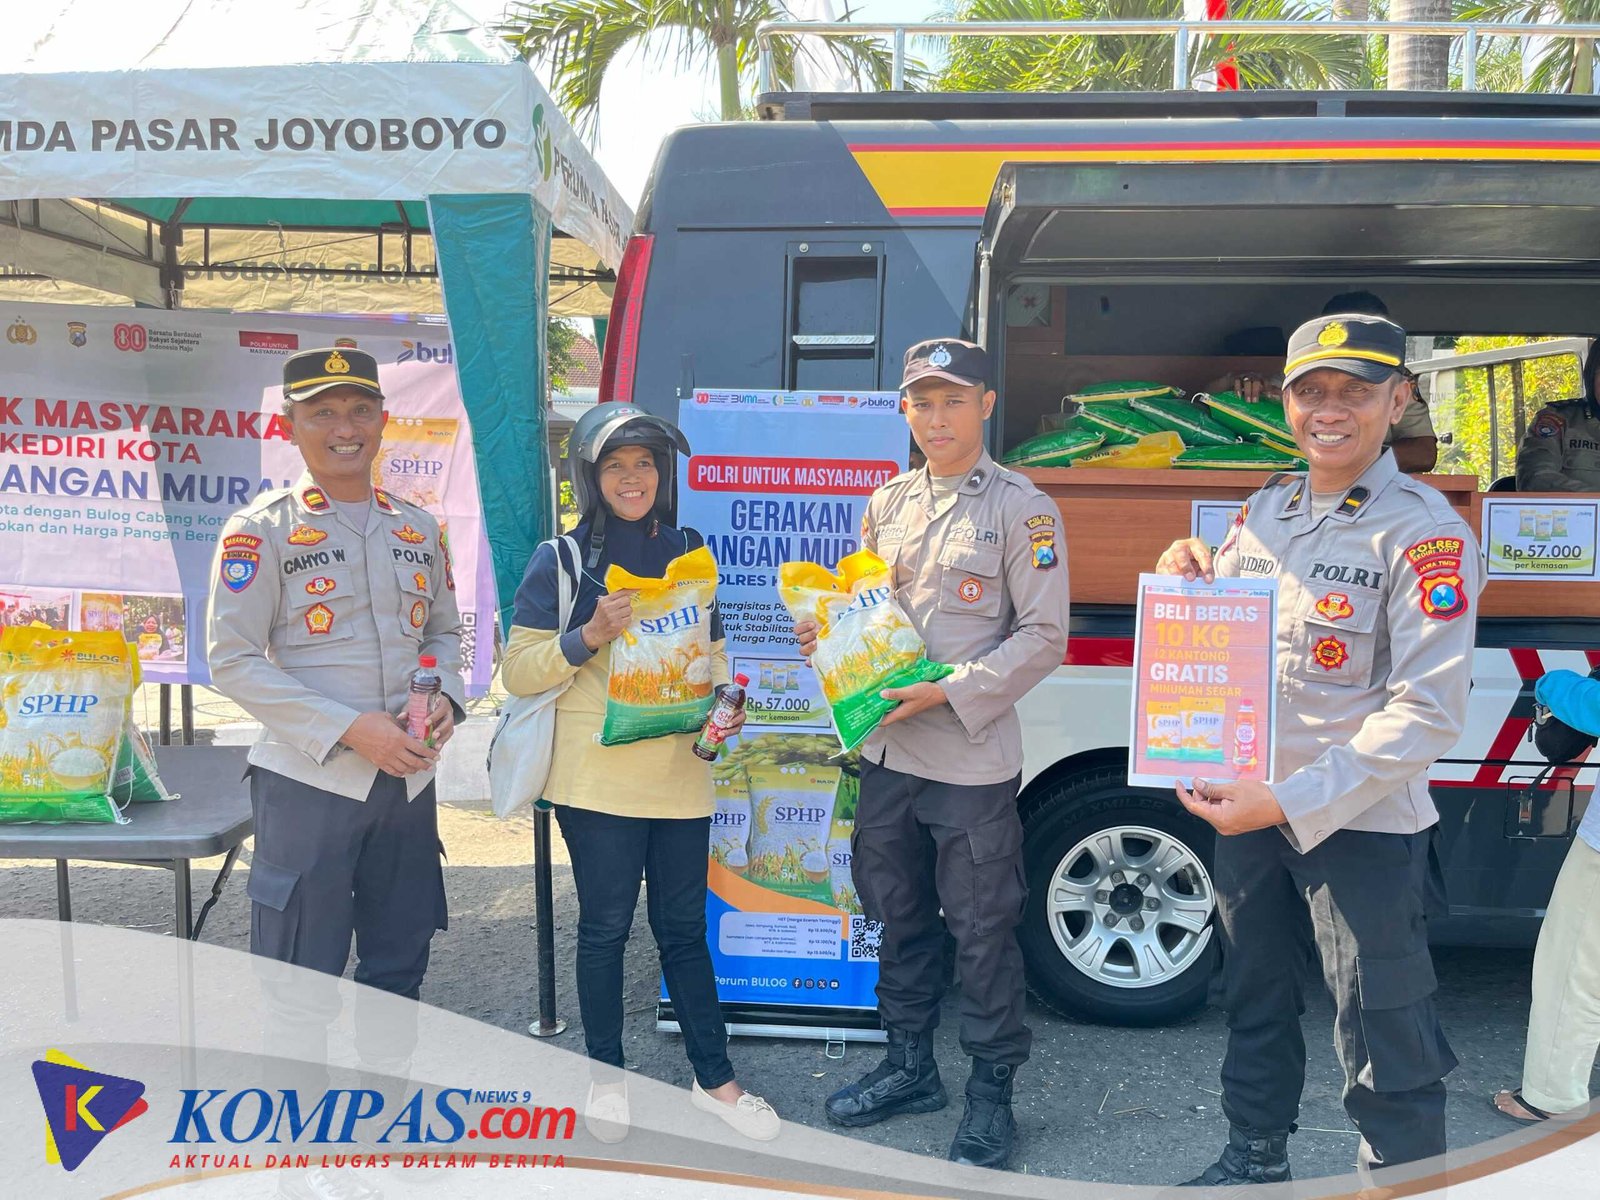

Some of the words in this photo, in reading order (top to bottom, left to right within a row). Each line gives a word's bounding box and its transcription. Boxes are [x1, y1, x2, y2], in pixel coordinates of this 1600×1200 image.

[91, 118, 240, 152] PASAR
[255, 117, 507, 151] JOYOBOYO
[0, 397, 24, 425] K
[868, 398, 896, 409] bulog
[0, 432, 105, 459] KEDIRI
[117, 438, 202, 465] KOTA
[390, 458, 443, 475] SPHP
[1, 463, 149, 500] ANGAN
[697, 465, 738, 484] POLRI
[743, 467, 791, 486] UNTUK
[795, 468, 892, 488] MASYARAKAT
[23, 505, 81, 520] dengan
[86, 508, 131, 524] Bulog
[136, 511, 193, 526] Cabang
[731, 499, 853, 534] GERAKAN
[39, 522, 67, 534] dan
[73, 524, 118, 539] Harga
[123, 527, 180, 542] Pangan
[185, 531, 218, 542] Bera
[954, 526, 999, 545] POLRI
[391, 548, 435, 567] POLRI
[1408, 540, 1460, 559] POLRES
[1503, 544, 1523, 560] Rp
[1527, 545, 1582, 558] 57.000
[283, 552, 329, 576] CAHYO
[332, 549, 346, 562] W
[1515, 562, 1530, 570] per
[1531, 561, 1568, 569] kemasan
[1308, 563, 1384, 591] POLRI
[743, 613, 773, 623] Bulog
[1154, 603, 1191, 620] BELI
[1196, 605, 1258, 622] BERAS
[745, 624, 794, 633] Stabilitas
[1156, 622, 1185, 647] 10
[1192, 624, 1231, 649] KG
[733, 634, 765, 644] Harga
[76, 652, 120, 663] BULOG
[873, 661, 883, 673] 5
[1150, 662, 1229, 683] GRATIS
[661, 688, 670, 698] 5
[1150, 684, 1203, 696] MINUMAN
[1206, 685, 1242, 697] SEGAR
[18, 694, 99, 717] SPHP
[747, 697, 763, 713] Rp
[766, 698, 811, 711] 57.000
[769, 713, 800, 721] kemasan
[1193, 717, 1219, 725] SPHP
[22, 773, 31, 787] 5
[775, 806, 826, 823] SPHP
[751, 977, 788, 987] BULOG
